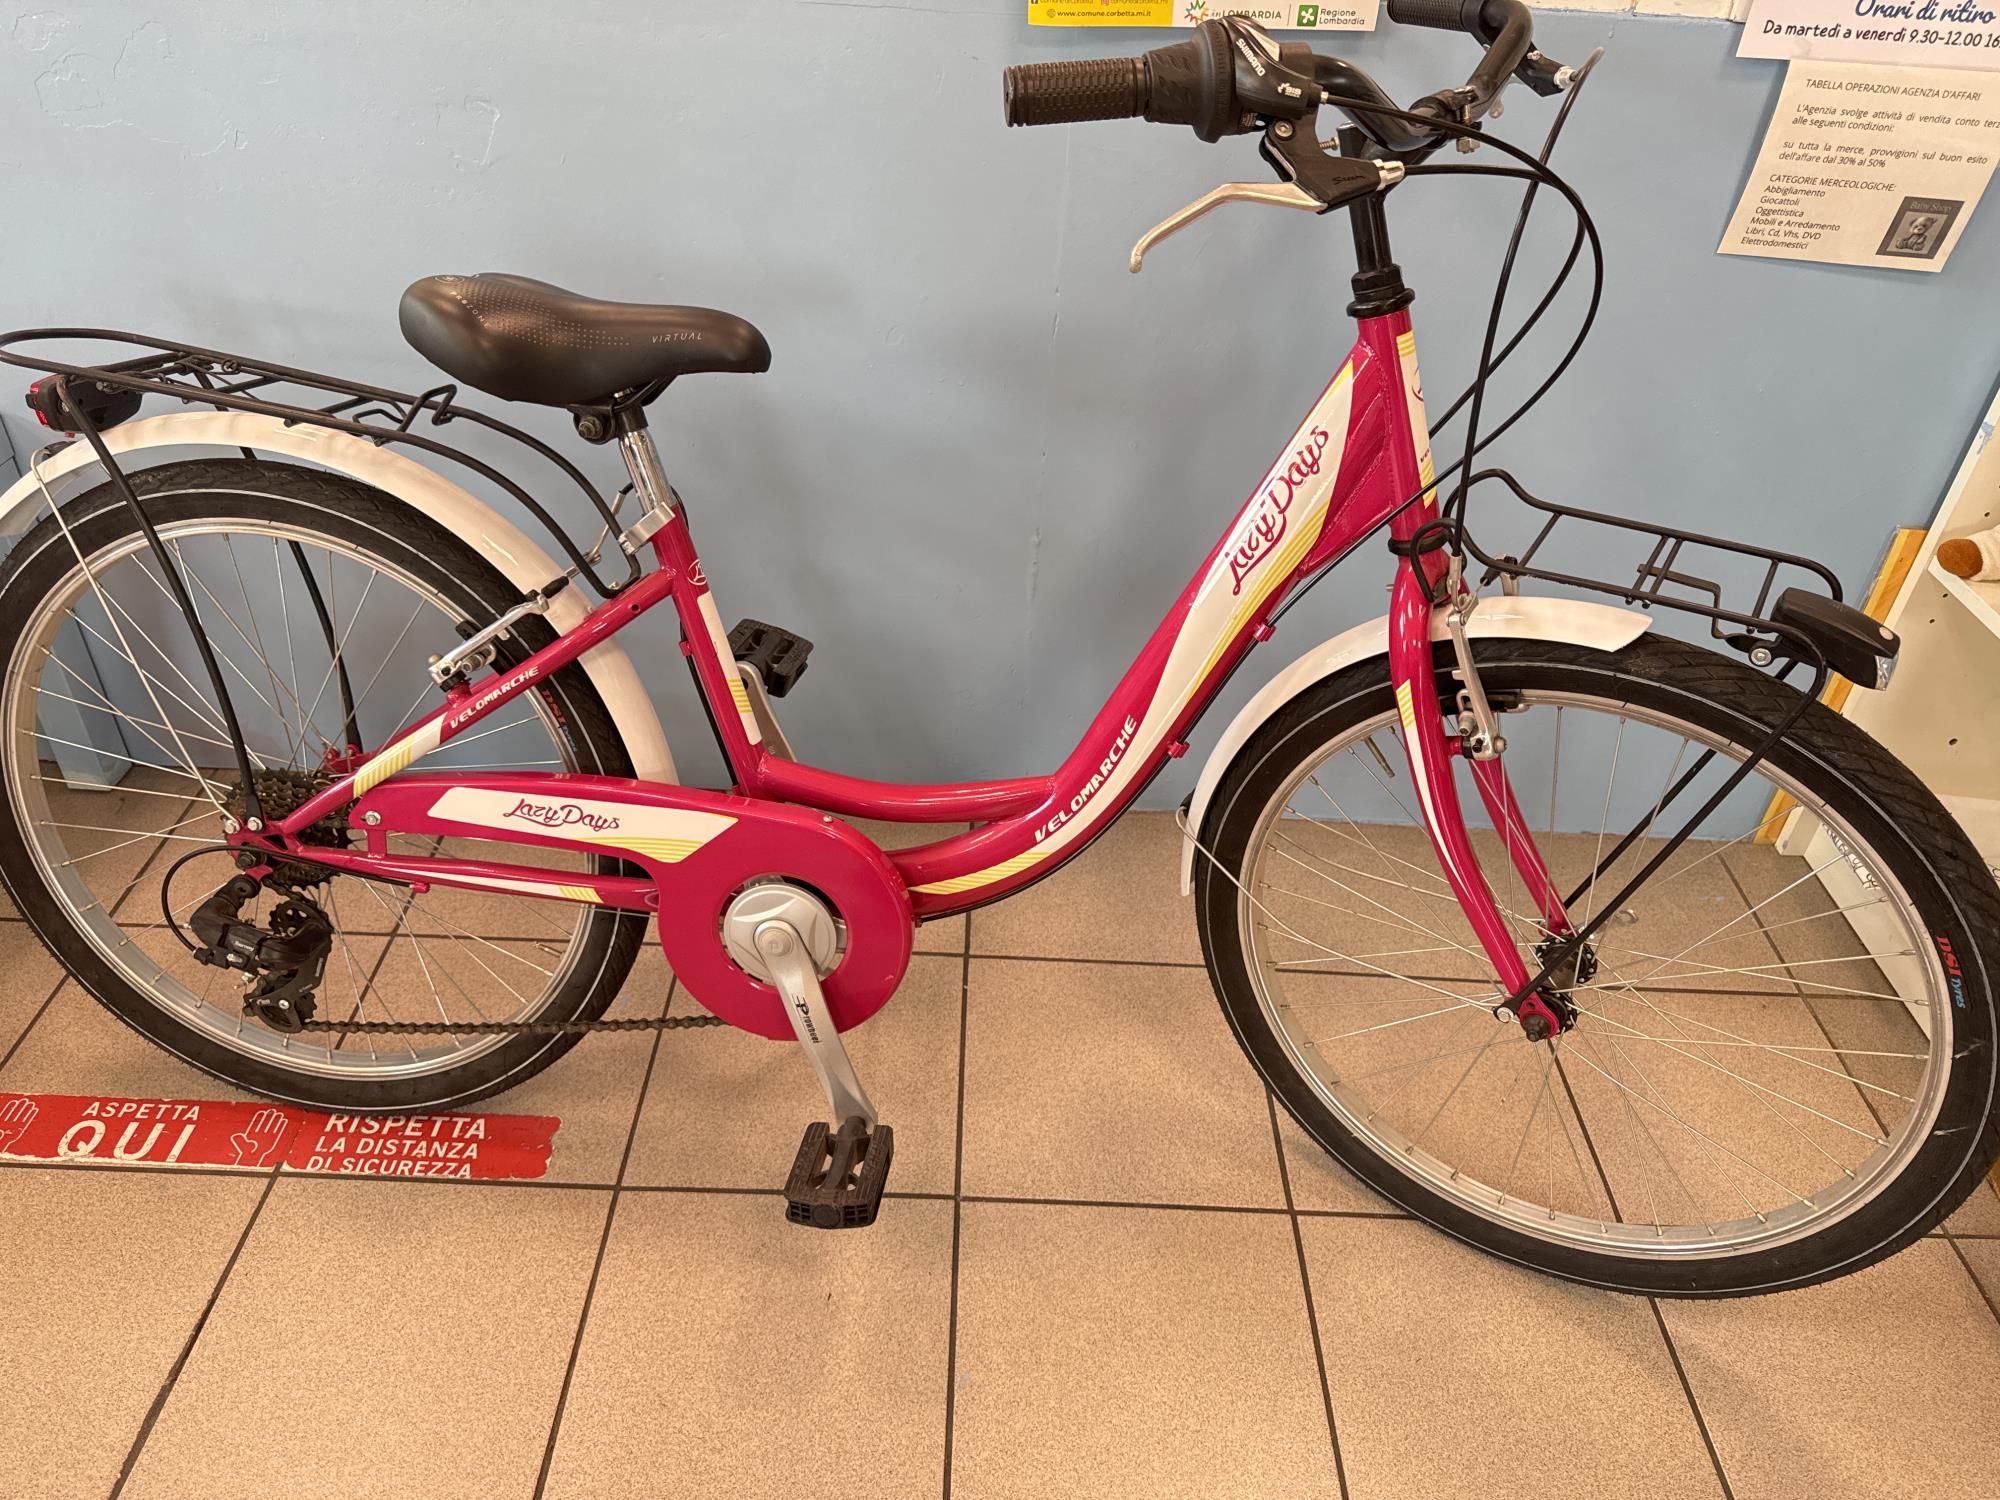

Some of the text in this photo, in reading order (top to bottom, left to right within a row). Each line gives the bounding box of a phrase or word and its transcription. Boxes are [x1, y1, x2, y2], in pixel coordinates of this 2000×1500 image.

[1057, 10, 1151, 18] www.comune.corbetta.mi.it
[1222, 10, 1282, 19] LOMBARDIA
[1319, 17, 1365, 26] Lombardia
[1320, 9, 1356, 18] Regione
[1855, 0, 1996, 24] Orari di ritiro
[1763, 20, 1782, 34] Da
[1843, 29, 1851, 38] a
[1908, 29, 1983, 48] 9.30-12.00
[1236, 38, 1266, 77] SHIMANO
[1806, 79, 1981, 101] TABELLA OPERAZIONI AGENZIA D'AFFARI
[1792, 116, 1895, 133] alle seguenti condizioni:
[1797, 104, 1837, 117] L'Agenzia
[1840, 107, 1868, 119] svolge
[1872, 109, 1902, 121] attività
[1906, 113, 1915, 121] di
[1919, 114, 1951, 125] vendita
[1955, 117, 1980, 127] conto
[1778, 151, 1886, 168] dell'affare dal 30% al 50%
[1783, 141, 1988, 165] su tutta la merce, provvigioni sul buon esito
[1764, 185, 1826, 198] Abbigliamento
[1769, 174, 1897, 192] CATEGORIE MERCEOLOGICHE:
[1760, 195, 1800, 206] Giocattoli
[1755, 206, 1804, 218] Oggettistica
[1745, 227, 1822, 240] Libri, Cd, Vhs, DVD
[1750, 216, 1777, 227] Mobili
[1784, 219, 1840, 231] Arredamento
[1740, 236, 1808, 249] Elettrodomestici
[449, 291, 491, 329] PROZONE
[652, 332, 703, 344] VIRTUAL
[1225, 425, 1329, 596] Lazy Days
[450, 666, 540, 729] VELOMARCHE
[1034, 714, 1137, 843] VELOMARCHE
[503, 798, 620, 832] Lazy Days
[1951, 978, 1966, 1009] Tyres
[82, 1101, 200, 1122] ASPETTA
[324, 1112, 487, 1140] RISPETTA
[57, 1119, 196, 1163] QUI
[314, 1135, 479, 1160] LA DISTANZA
[306, 1155, 473, 1179] DI SICUREZZA
